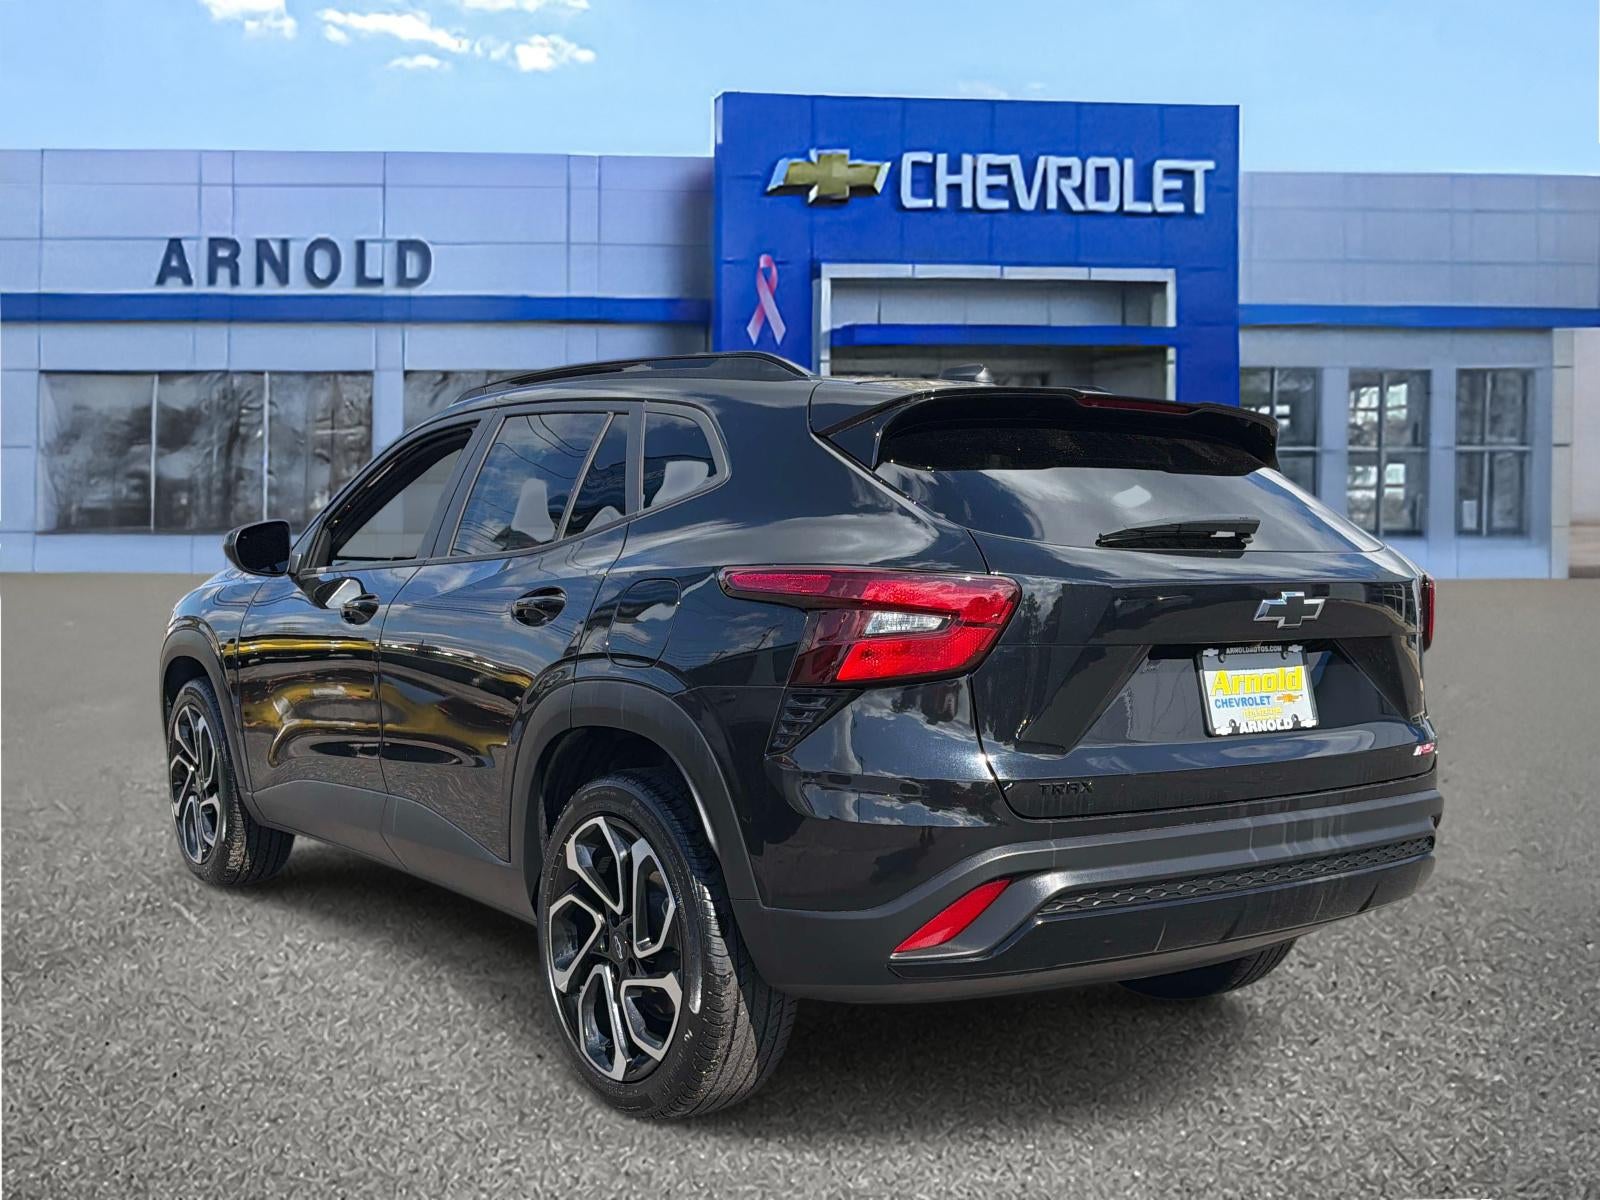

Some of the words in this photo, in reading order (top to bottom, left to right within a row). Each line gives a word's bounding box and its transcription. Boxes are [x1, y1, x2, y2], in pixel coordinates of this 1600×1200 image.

[900, 151, 1216, 215] CHEVROLET
[154, 236, 432, 289] ARNOLD
[1211, 667, 1303, 696] Arnold
[1215, 696, 1271, 709] CHEVROLET
[1240, 718, 1293, 733] ARNOLD
